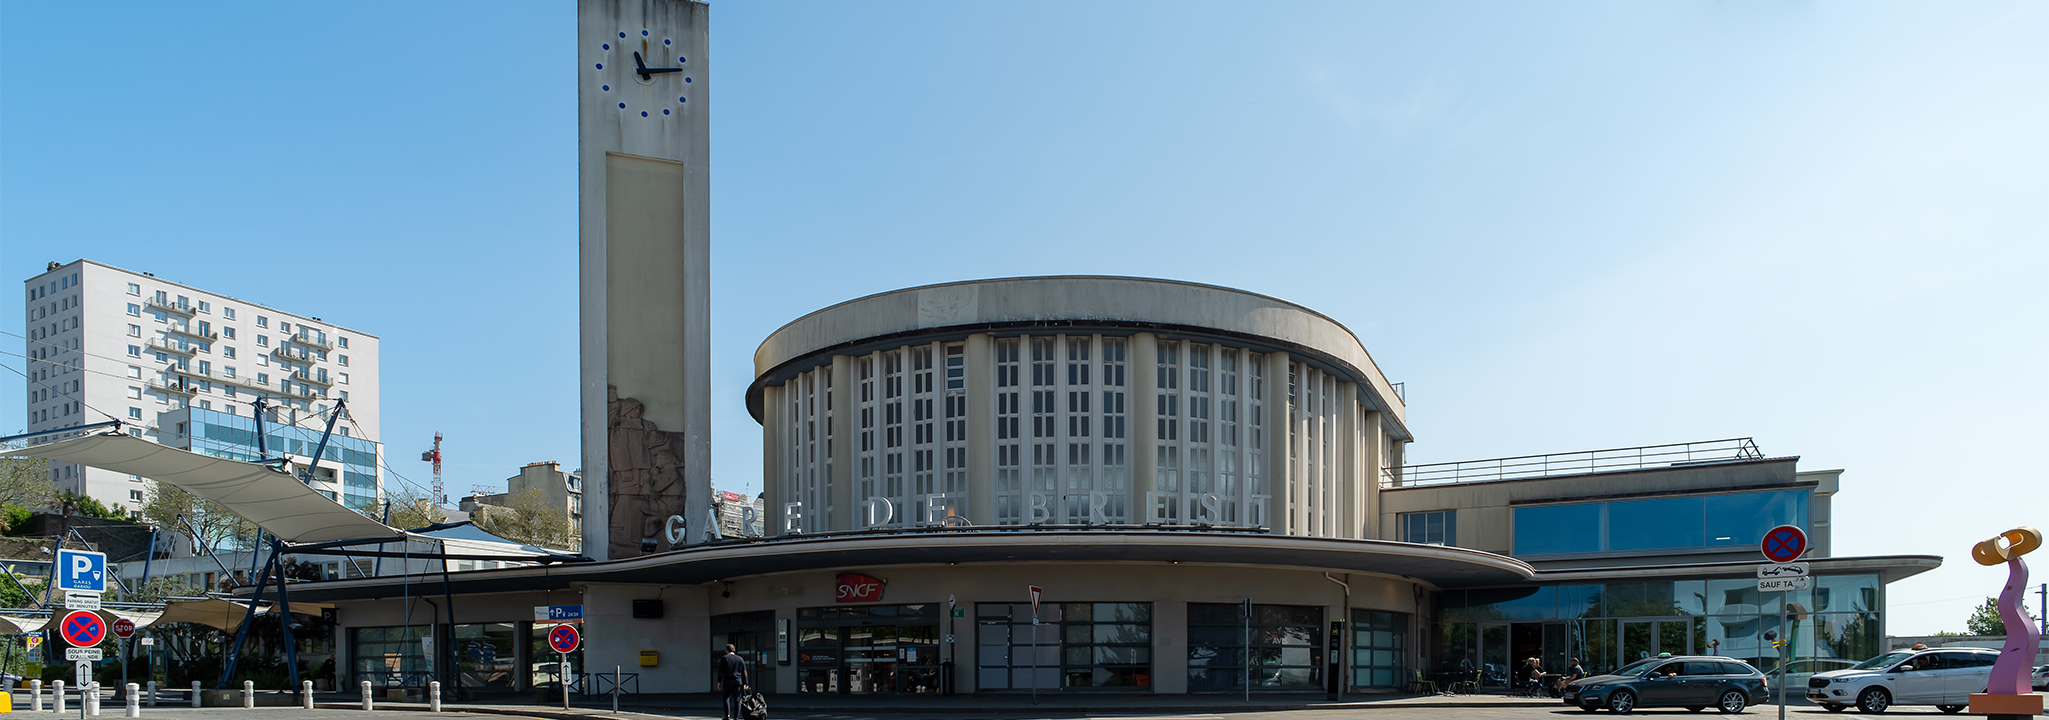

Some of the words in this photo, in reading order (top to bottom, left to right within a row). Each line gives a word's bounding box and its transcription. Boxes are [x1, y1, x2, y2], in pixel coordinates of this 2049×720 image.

[664, 501, 802, 545] GARE
[867, 492, 946, 528] DE
[1028, 490, 1272, 528] BREST
[72, 555, 92, 580] P
[837, 583, 879, 599] SNCF
[555, 607, 562, 617] P
[115, 624, 133, 632] STOP
[1271, 637, 1288, 645] AVIS
